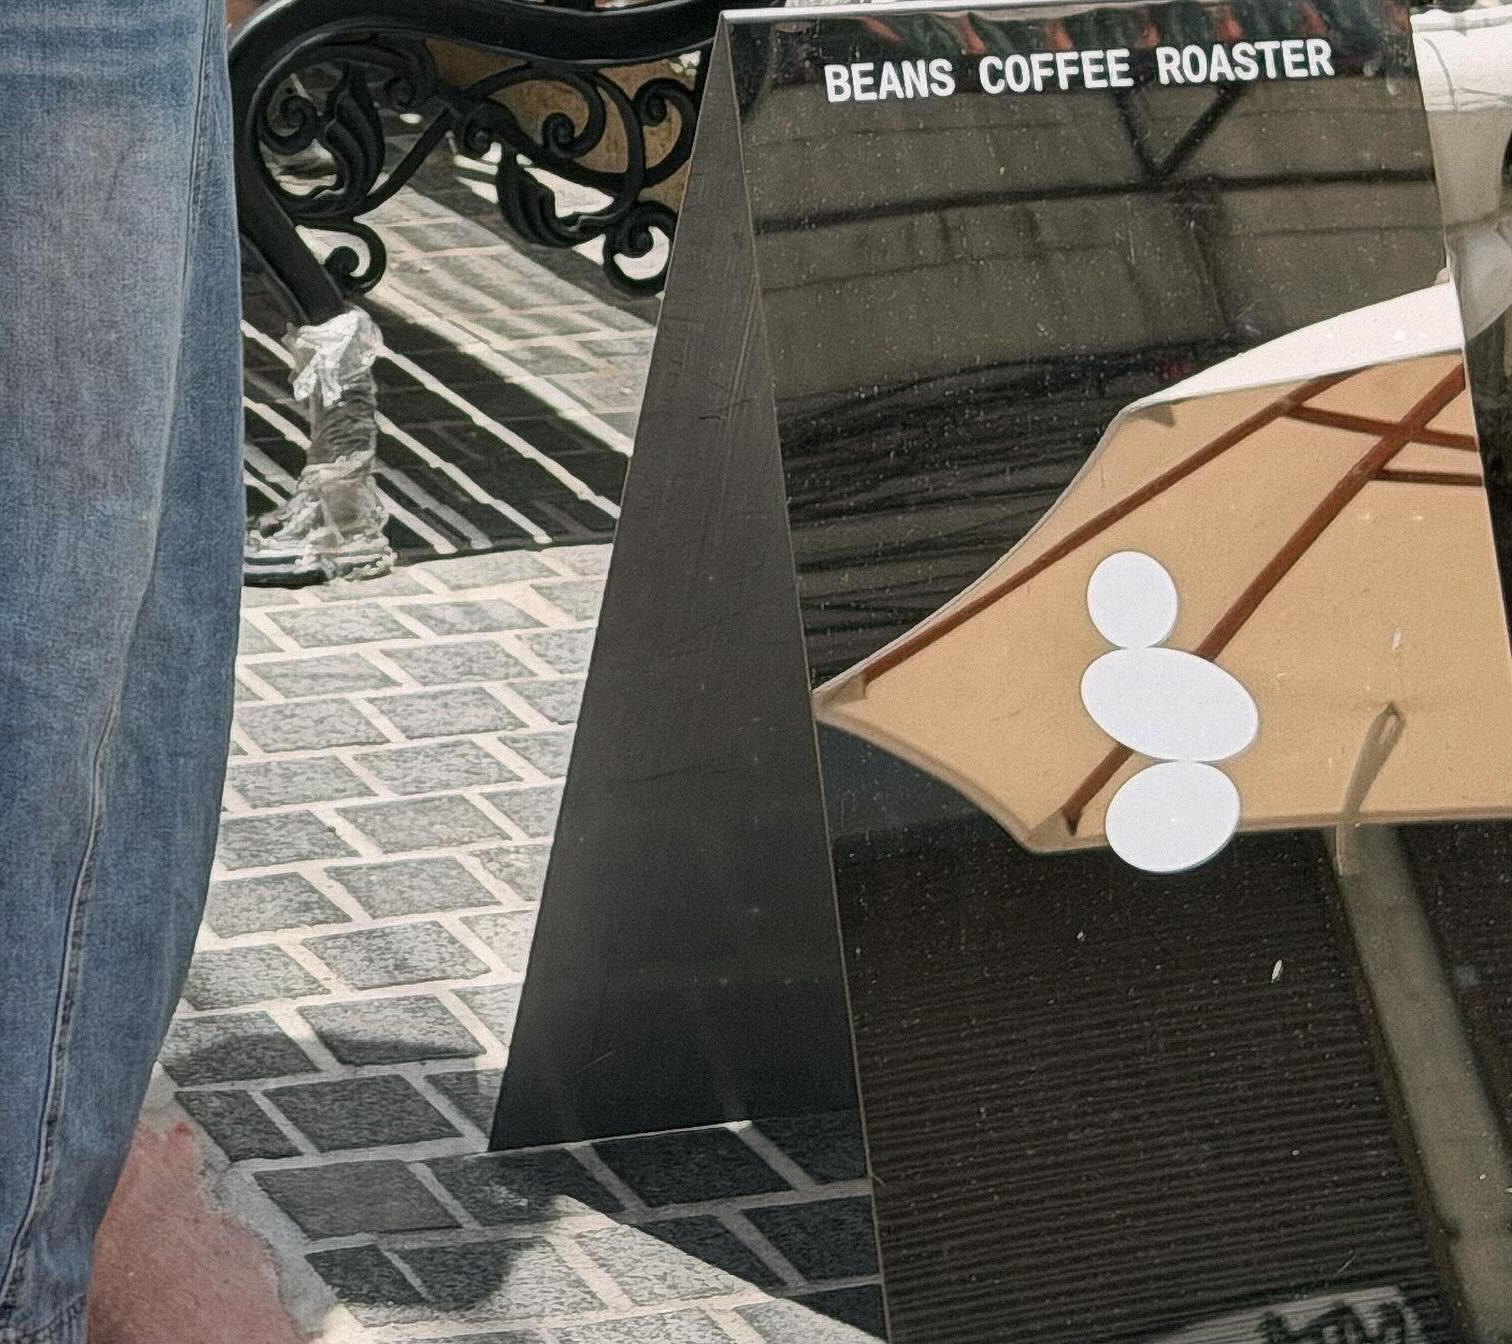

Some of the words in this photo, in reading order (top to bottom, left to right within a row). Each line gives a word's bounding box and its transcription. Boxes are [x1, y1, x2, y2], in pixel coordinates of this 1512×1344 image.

[824, 58, 956, 104] BEANS
[979, 48, 1135, 96] COFFEE
[1156, 38, 1336, 85] ROASTER
